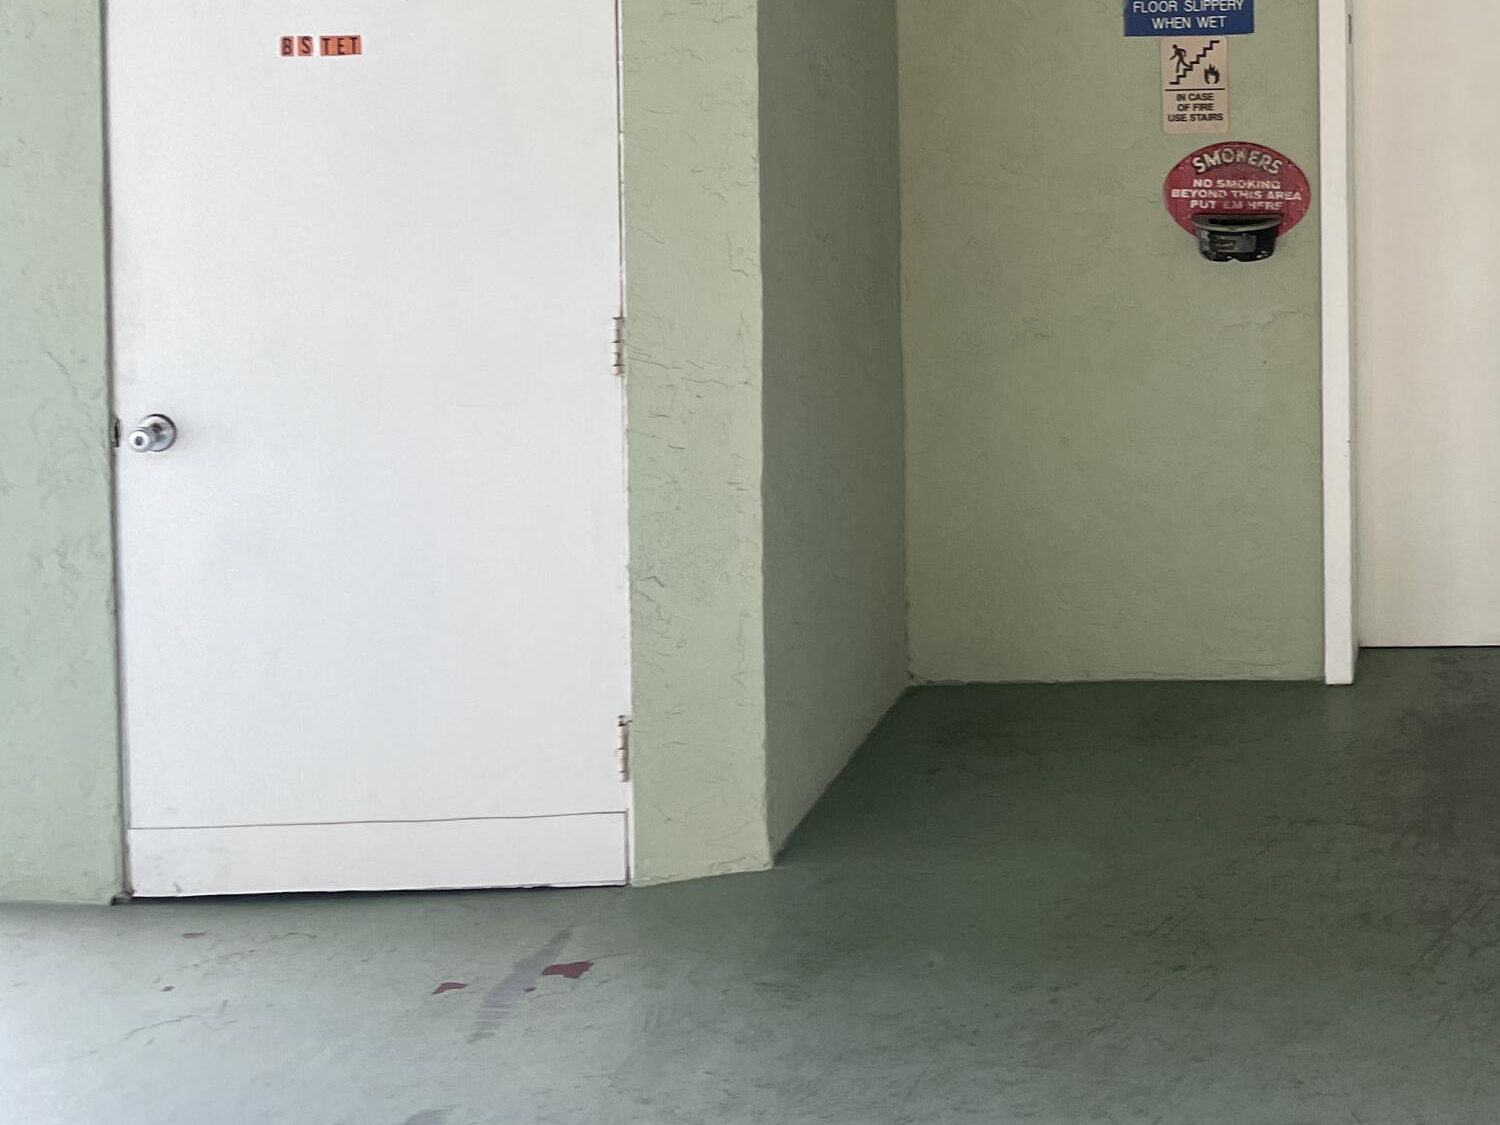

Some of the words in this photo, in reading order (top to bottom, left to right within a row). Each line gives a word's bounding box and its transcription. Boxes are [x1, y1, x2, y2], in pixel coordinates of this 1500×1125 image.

[1132, 0, 1178, 13] FLOOR
[1151, 17, 1191, 29] WHEN
[1196, 15, 1227, 28] WET
[1176, 93, 1186, 101] IN
[1188, 92, 1215, 101] CASE
[1177, 103, 1191, 111] OF
[1192, 103, 1215, 111] FIRE
[1167, 114, 1188, 122] USE
[1189, 113, 1224, 122] STAIRS
[1192, 148, 1283, 175] SMOKERS
[1193, 178, 1213, 188] NO
[1216, 179, 1281, 190] SMOKING
[1170, 188, 1228, 199] BEYOND
[1230, 189, 1262, 200] THIS
[1266, 190, 1302, 201] AREA
[1189, 199, 1216, 209] PUT
